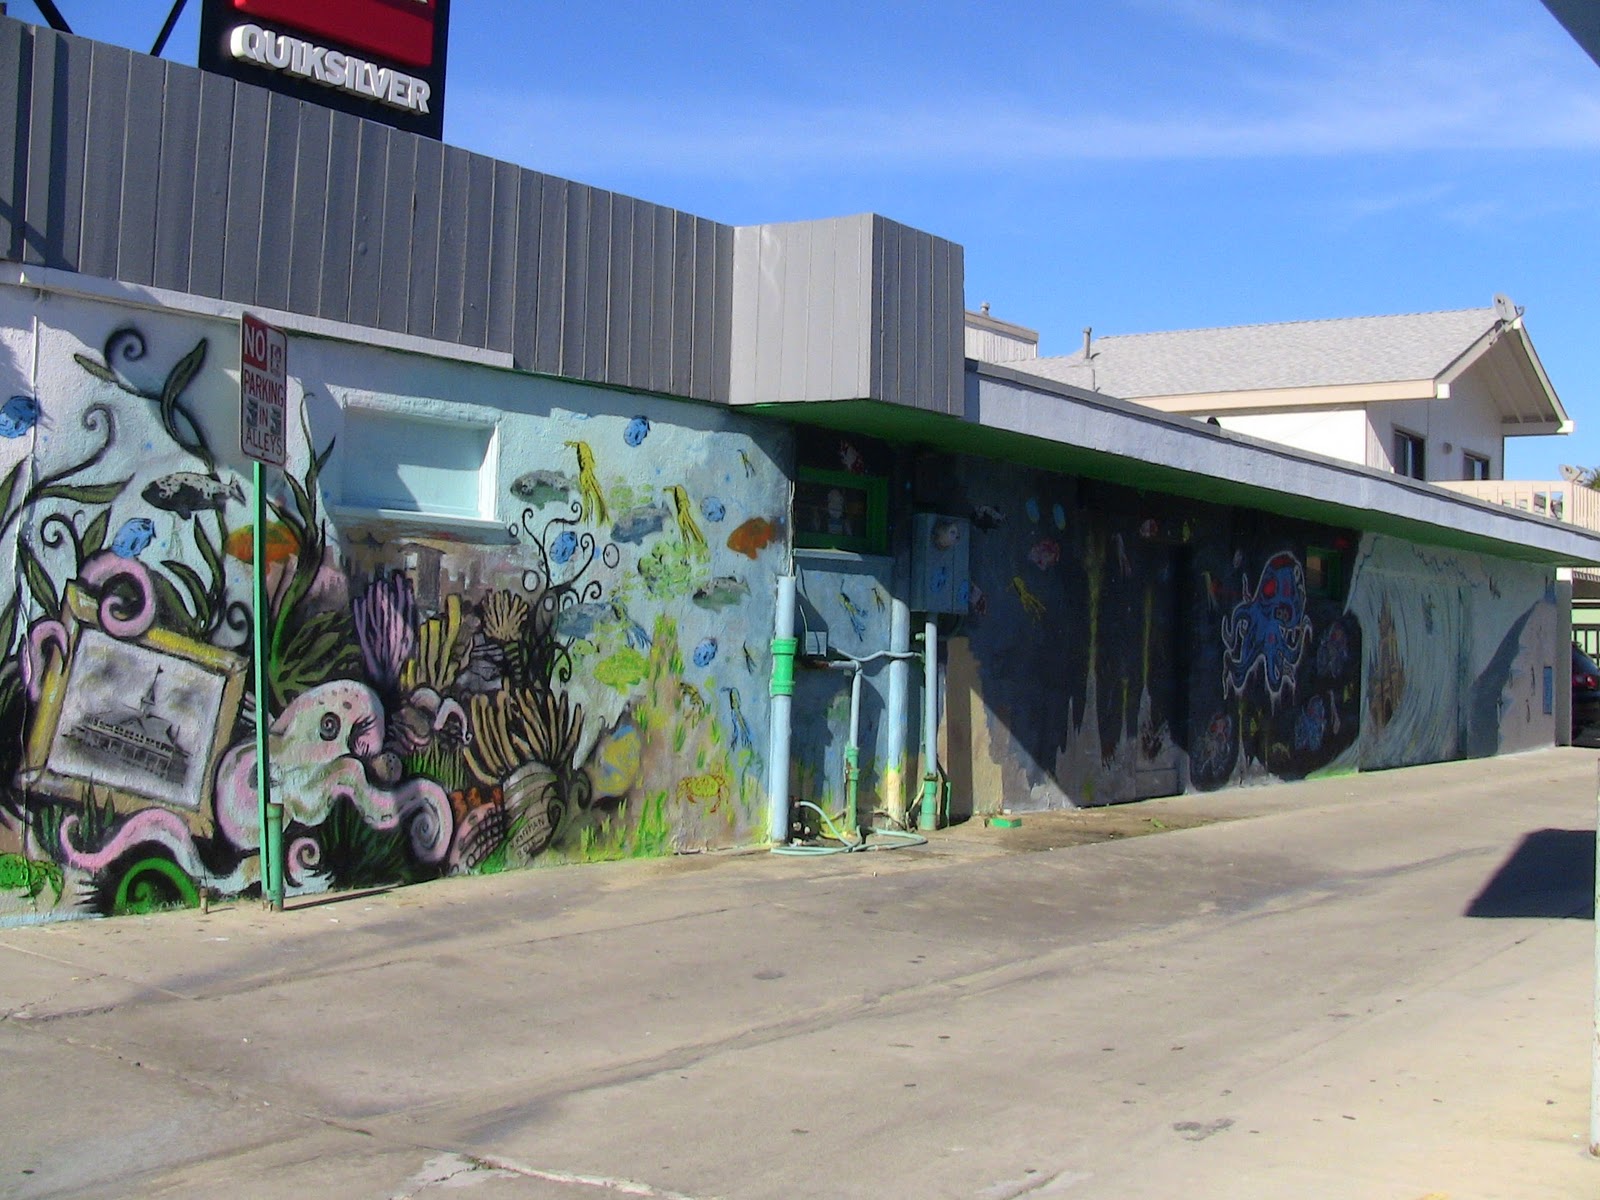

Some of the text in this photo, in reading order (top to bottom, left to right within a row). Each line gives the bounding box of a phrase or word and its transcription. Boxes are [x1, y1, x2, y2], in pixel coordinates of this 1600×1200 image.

[231, 24, 431, 114] QUIKSILVER
[244, 323, 267, 363] NO
[244, 370, 284, 407] PARKING
[259, 407, 269, 428] IN
[245, 428, 283, 456] ALLEYS
